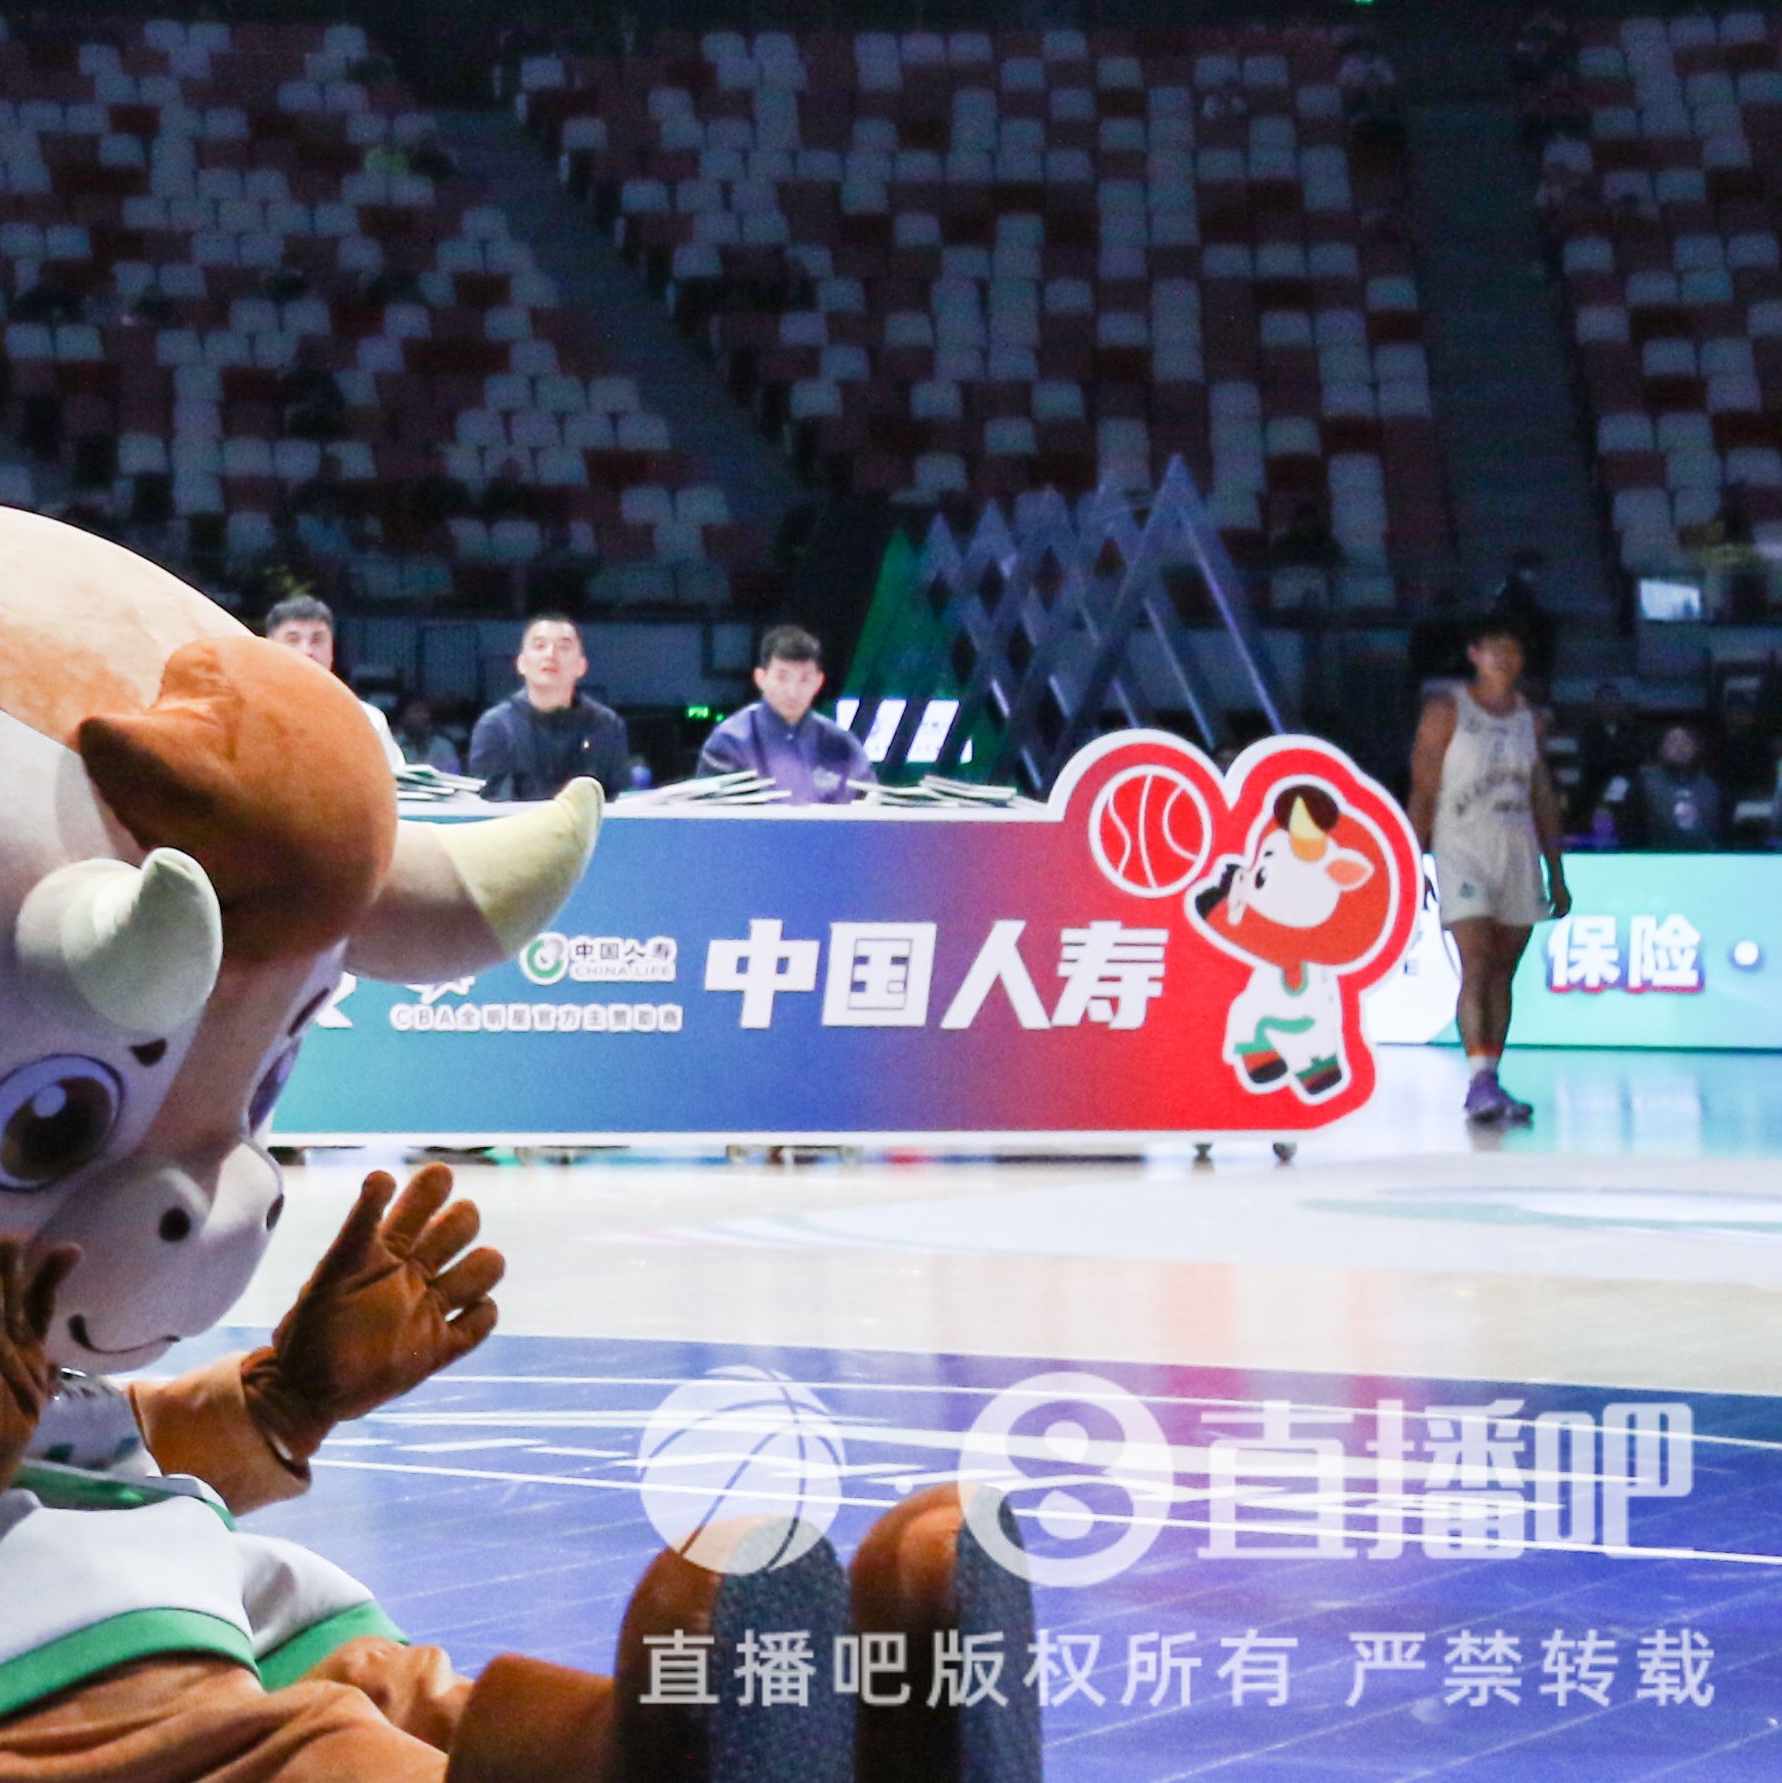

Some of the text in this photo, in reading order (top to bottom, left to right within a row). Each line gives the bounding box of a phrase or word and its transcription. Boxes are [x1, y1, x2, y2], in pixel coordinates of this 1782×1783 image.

[575, 941, 671, 964] 中国人寿
[575, 965, 672, 978] CHINA LIFE
[703, 918, 1170, 1031] 中国人寿
[1547, 914, 1703, 993] 保险
